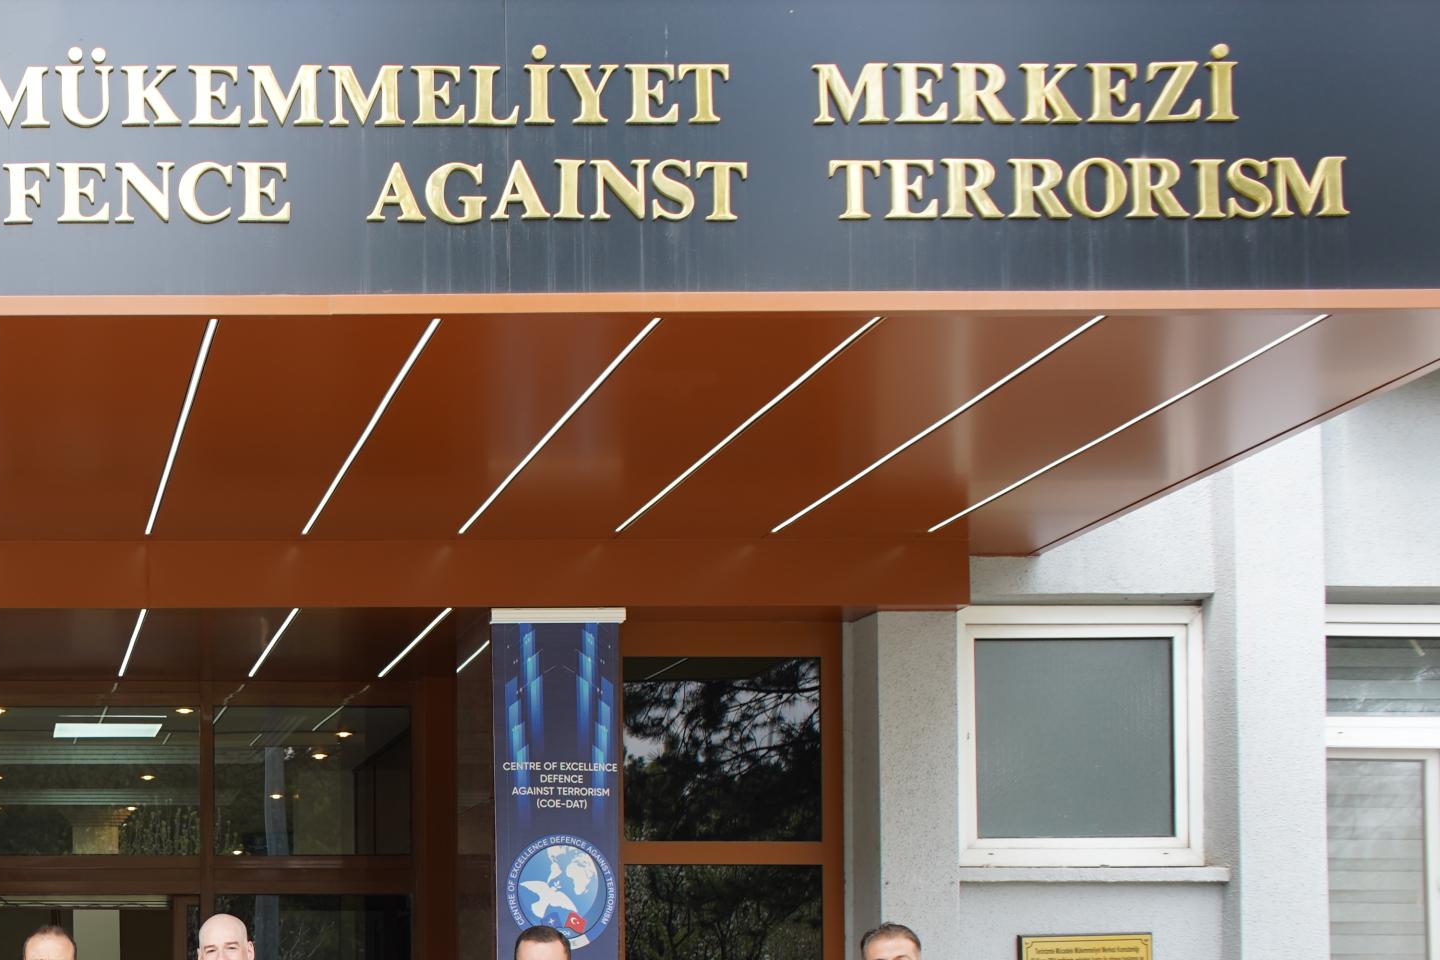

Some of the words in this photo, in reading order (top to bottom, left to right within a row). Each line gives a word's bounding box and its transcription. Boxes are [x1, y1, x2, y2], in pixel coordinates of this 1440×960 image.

[811, 43, 1240, 125] MERKEZİ
[366, 158, 748, 224] AGAINST
[828, 156, 1351, 221] TERRORISM
[502, 762, 541, 771] CENTRE
[544, 762, 557, 771] OF
[560, 762, 618, 772] EXCELLENCE
[540, 775, 584, 783] DEFENCE
[512, 787, 554, 795] AGAINST
[557, 787, 610, 797] TERRORISM
[537, 799, 588, 809] (COE-DAT)
[550, 836, 585, 849] DEFENCE
[511, 839, 548, 879] EXCELLENCE
[587, 845, 610, 876] AGAINST
[507, 880, 515, 892] OF
[508, 894, 524, 926] CENTRE
[602, 876, 616, 925] TERRORISM
